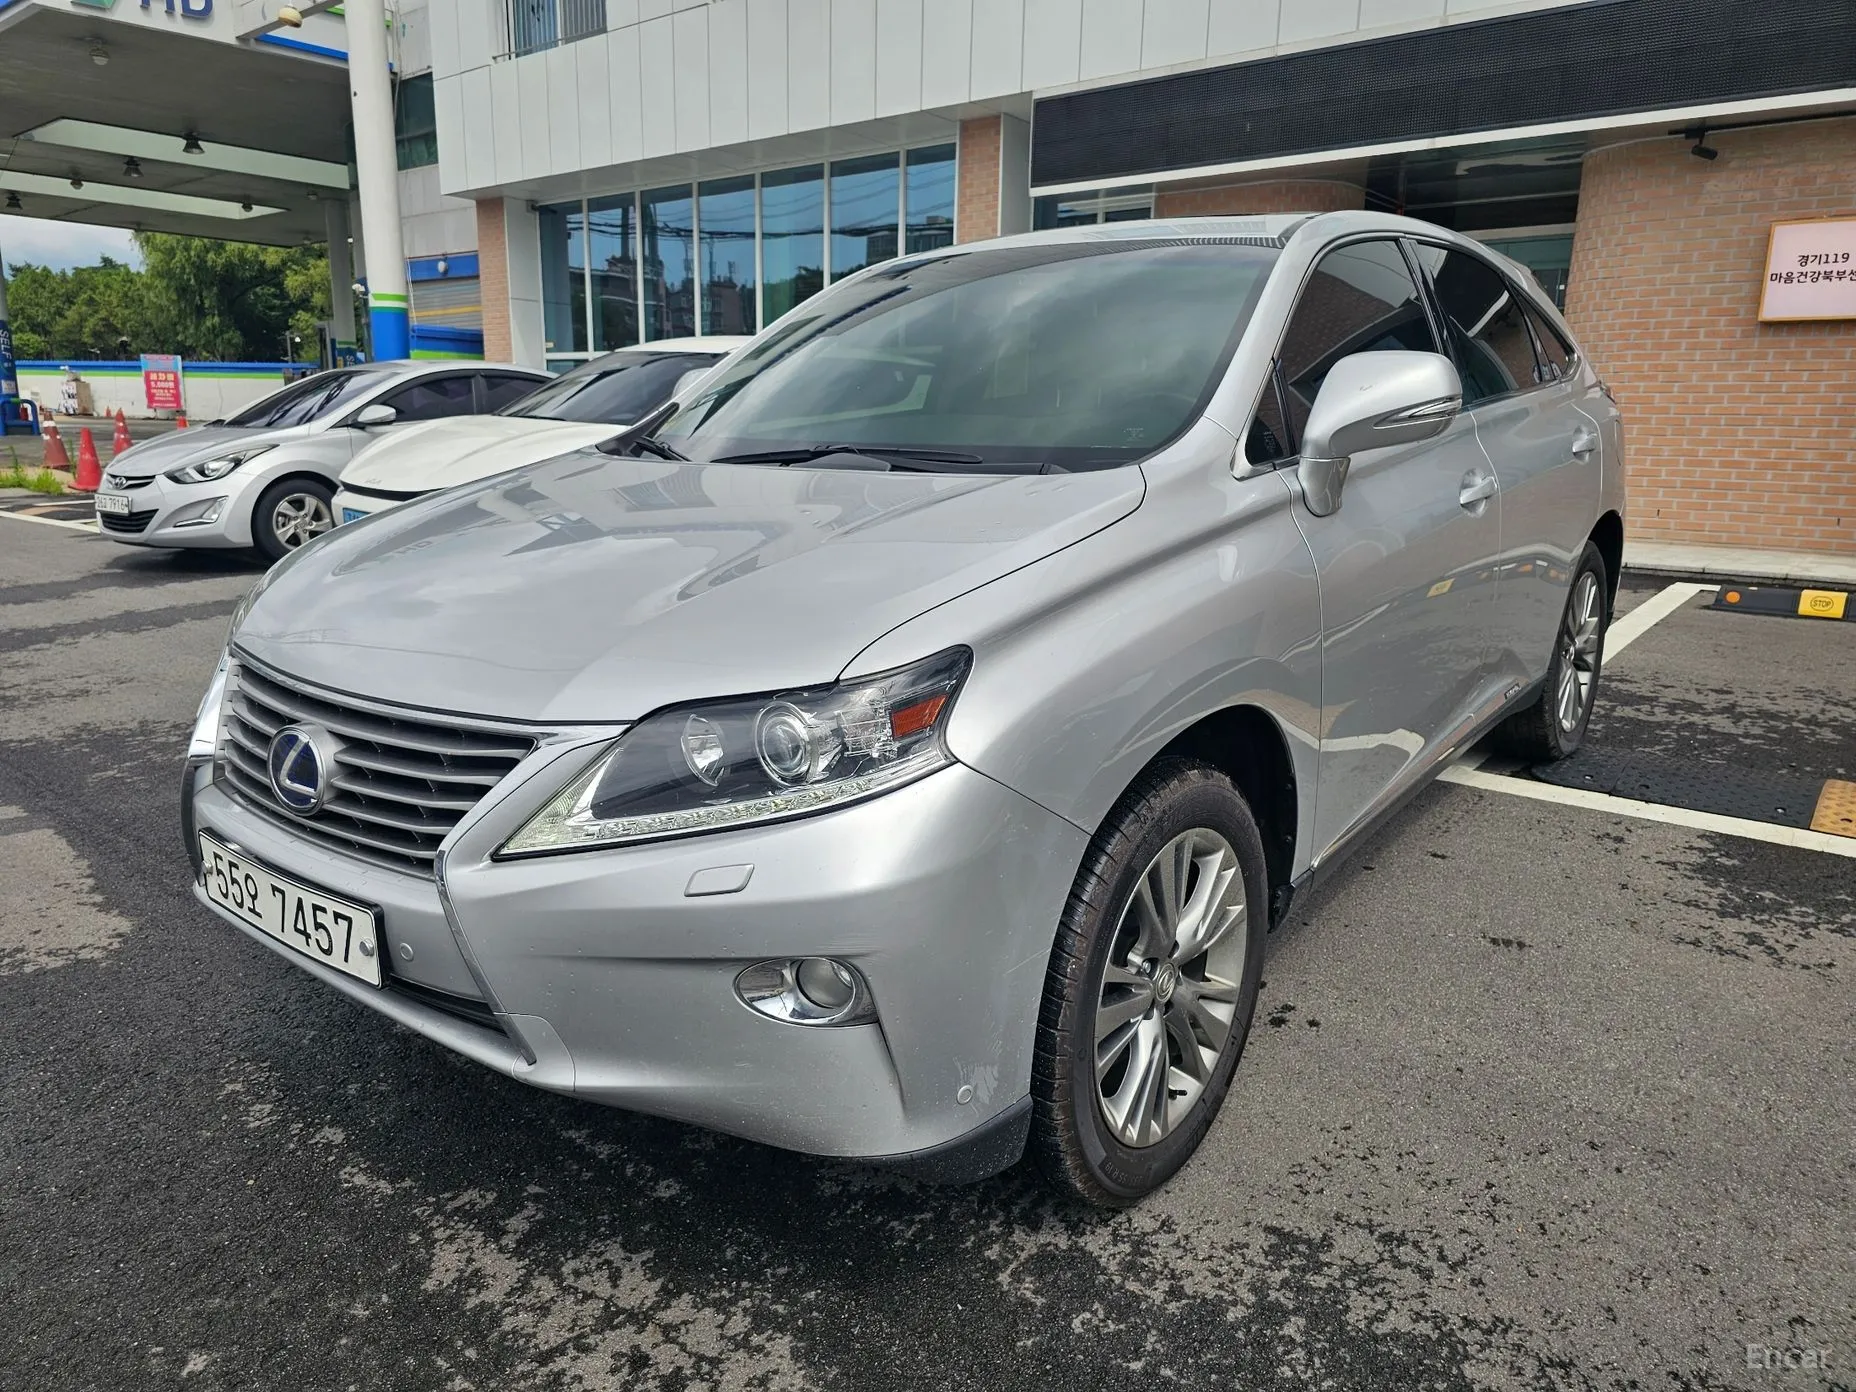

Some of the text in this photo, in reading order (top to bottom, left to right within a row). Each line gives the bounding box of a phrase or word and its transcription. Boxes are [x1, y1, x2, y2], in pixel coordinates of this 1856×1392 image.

[1798, 252, 1850, 268] 경기119
[1813, 599, 1832, 608] STOP
[212, 850, 353, 963] 55오 7457
